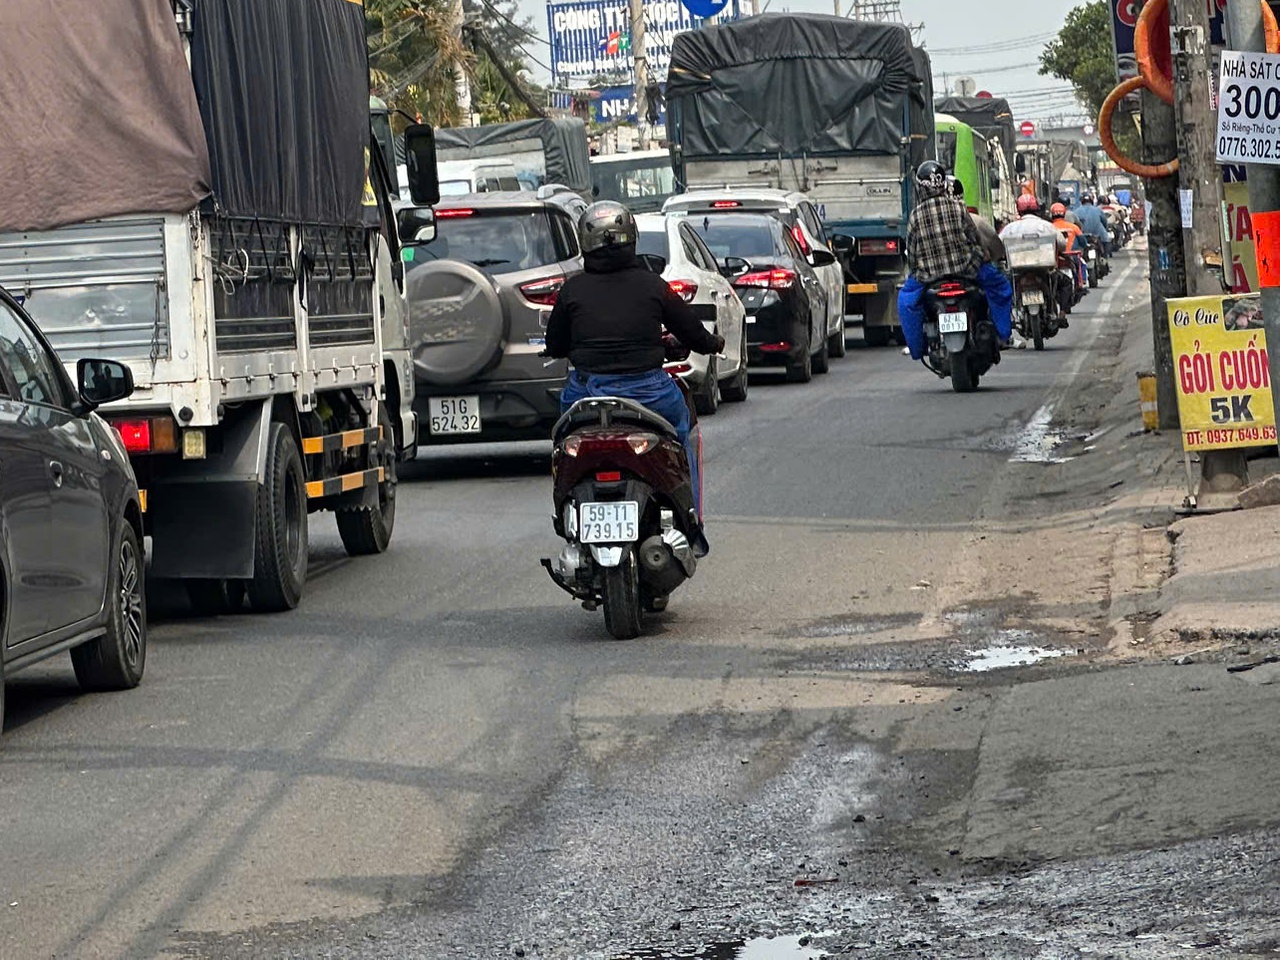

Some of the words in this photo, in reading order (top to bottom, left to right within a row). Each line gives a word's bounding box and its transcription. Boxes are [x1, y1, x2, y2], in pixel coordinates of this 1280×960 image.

[554, 6, 600, 32] CÔNG
[1223, 56, 1247, 78] NHÀ
[1250, 58, 1273, 80] SÁT
[1179, 340, 1215, 394] GỎI
[441, 399, 468, 415] 51G
[1210, 395, 1255, 424] 5K
[432, 415, 479, 432] 524.32
[589, 505, 627, 522] 59-T1
[584, 522, 635, 540] 739.15
